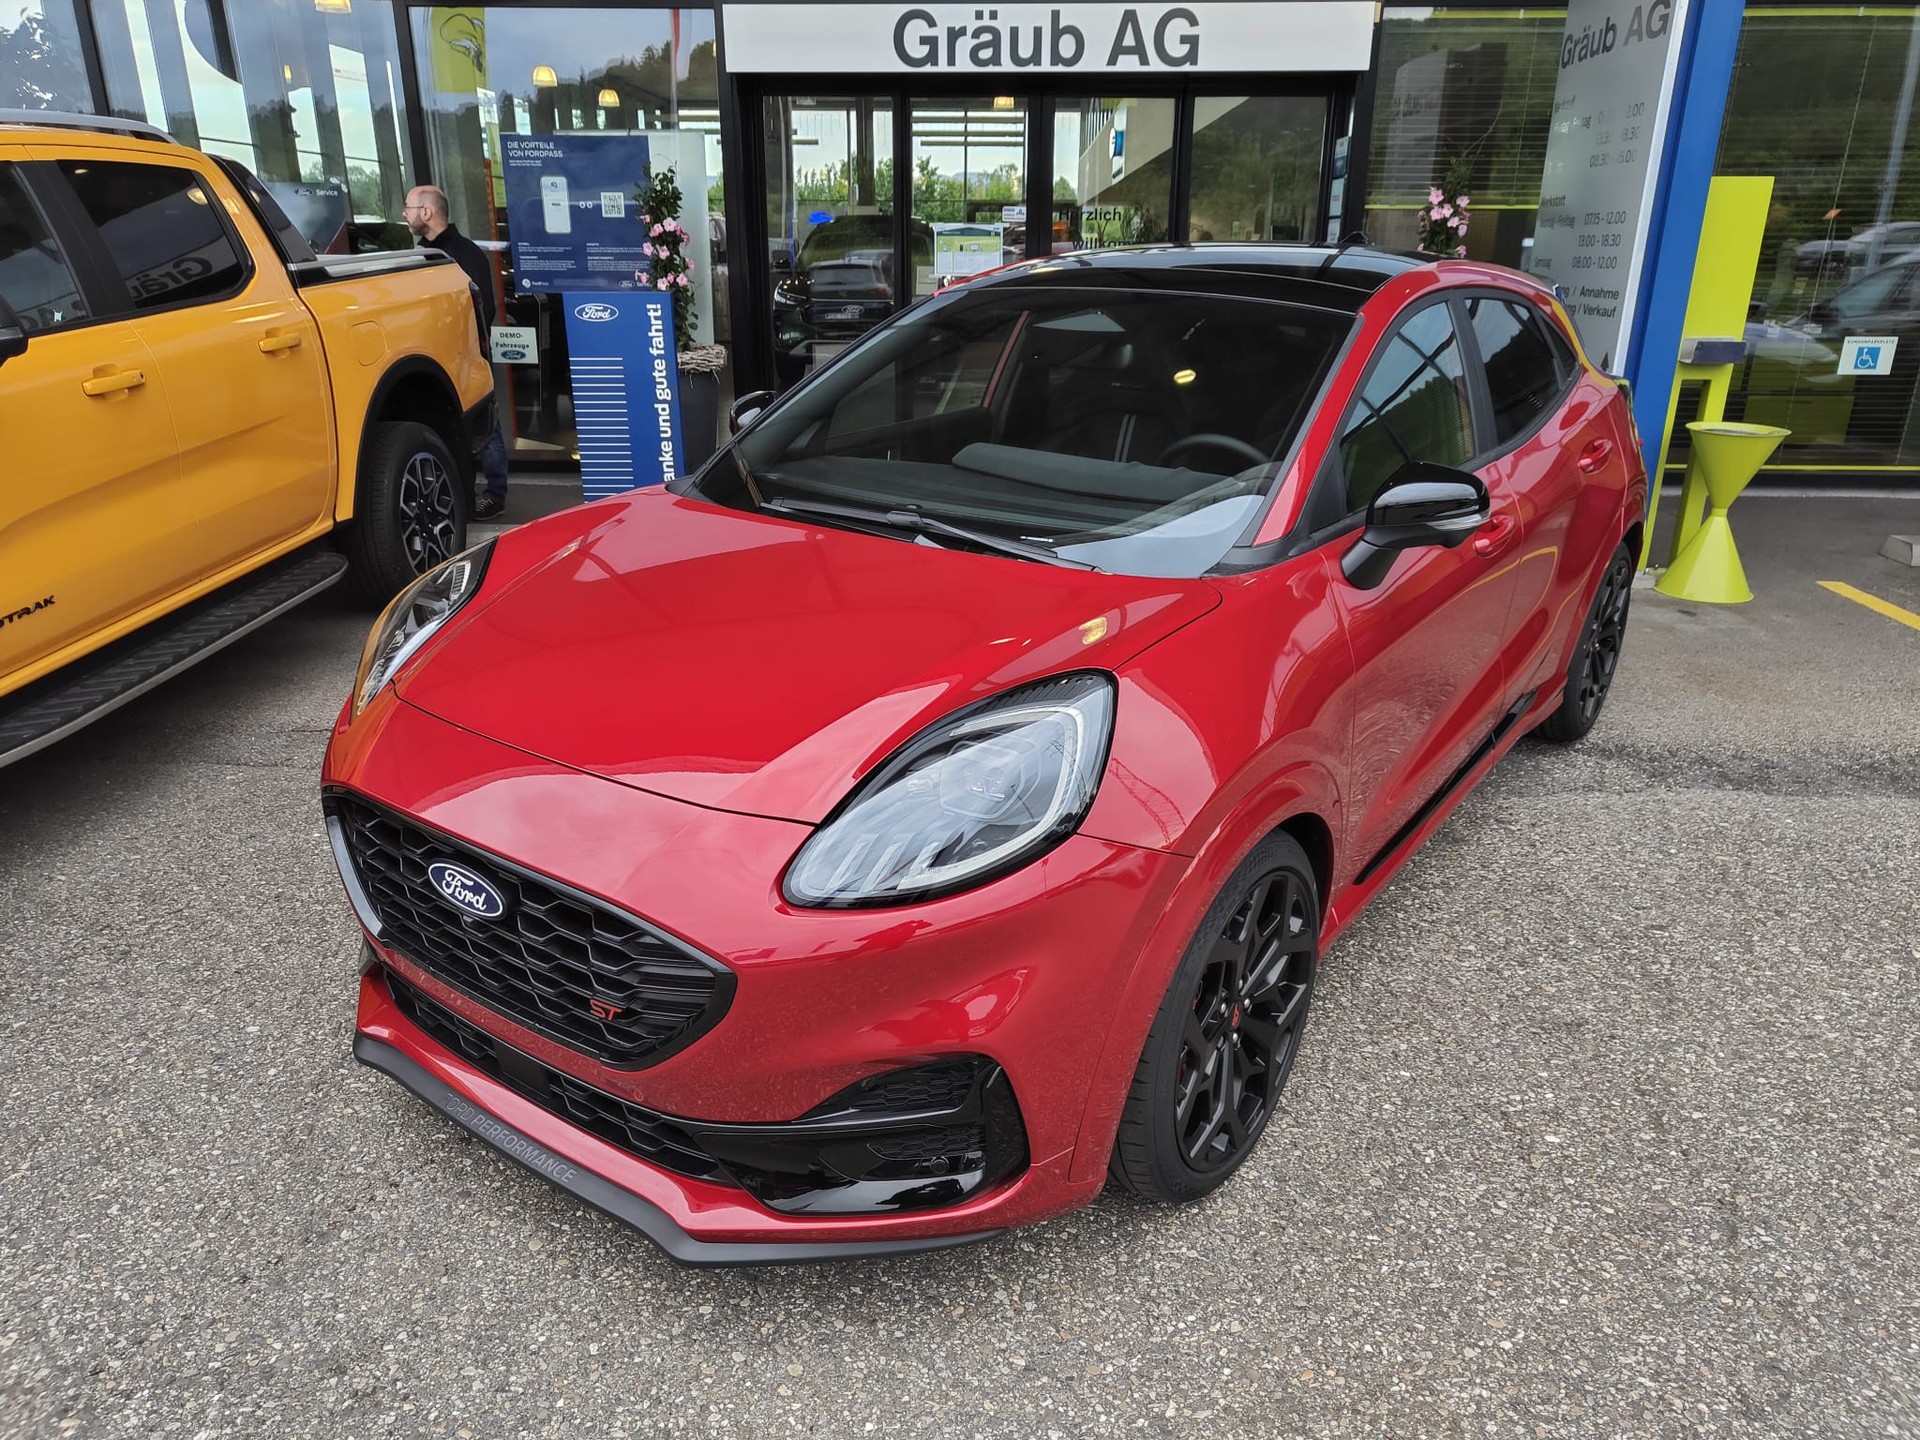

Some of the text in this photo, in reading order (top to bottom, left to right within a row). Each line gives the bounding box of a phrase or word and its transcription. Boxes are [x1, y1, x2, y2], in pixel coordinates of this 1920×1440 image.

[893, 7, 1200, 68] Gräub AG
[1561, 0, 1671, 69] Gräub AG
[507, 141, 555, 149] DIE VORTEILE
[508, 150, 563, 158] VON FORDPASS
[316, 188, 338, 196] Service
[1606, 211, 1627, 225] 12.00
[1578, 235, 1596, 248] 13.00
[1601, 234, 1622, 247] 18.30
[1572, 256, 1592, 269] 08.00
[1597, 256, 1618, 269] 12.00
[1580, 286, 1619, 300] Annahme
[1583, 303, 1617, 318] Verkauf
[495, 341, 530, 350] Fahrzeuge
[646, 303, 676, 482] anke und gute fahrt!
[590, 999, 623, 1021] ST
[471, 1114, 578, 1183] PERFORMANCE
